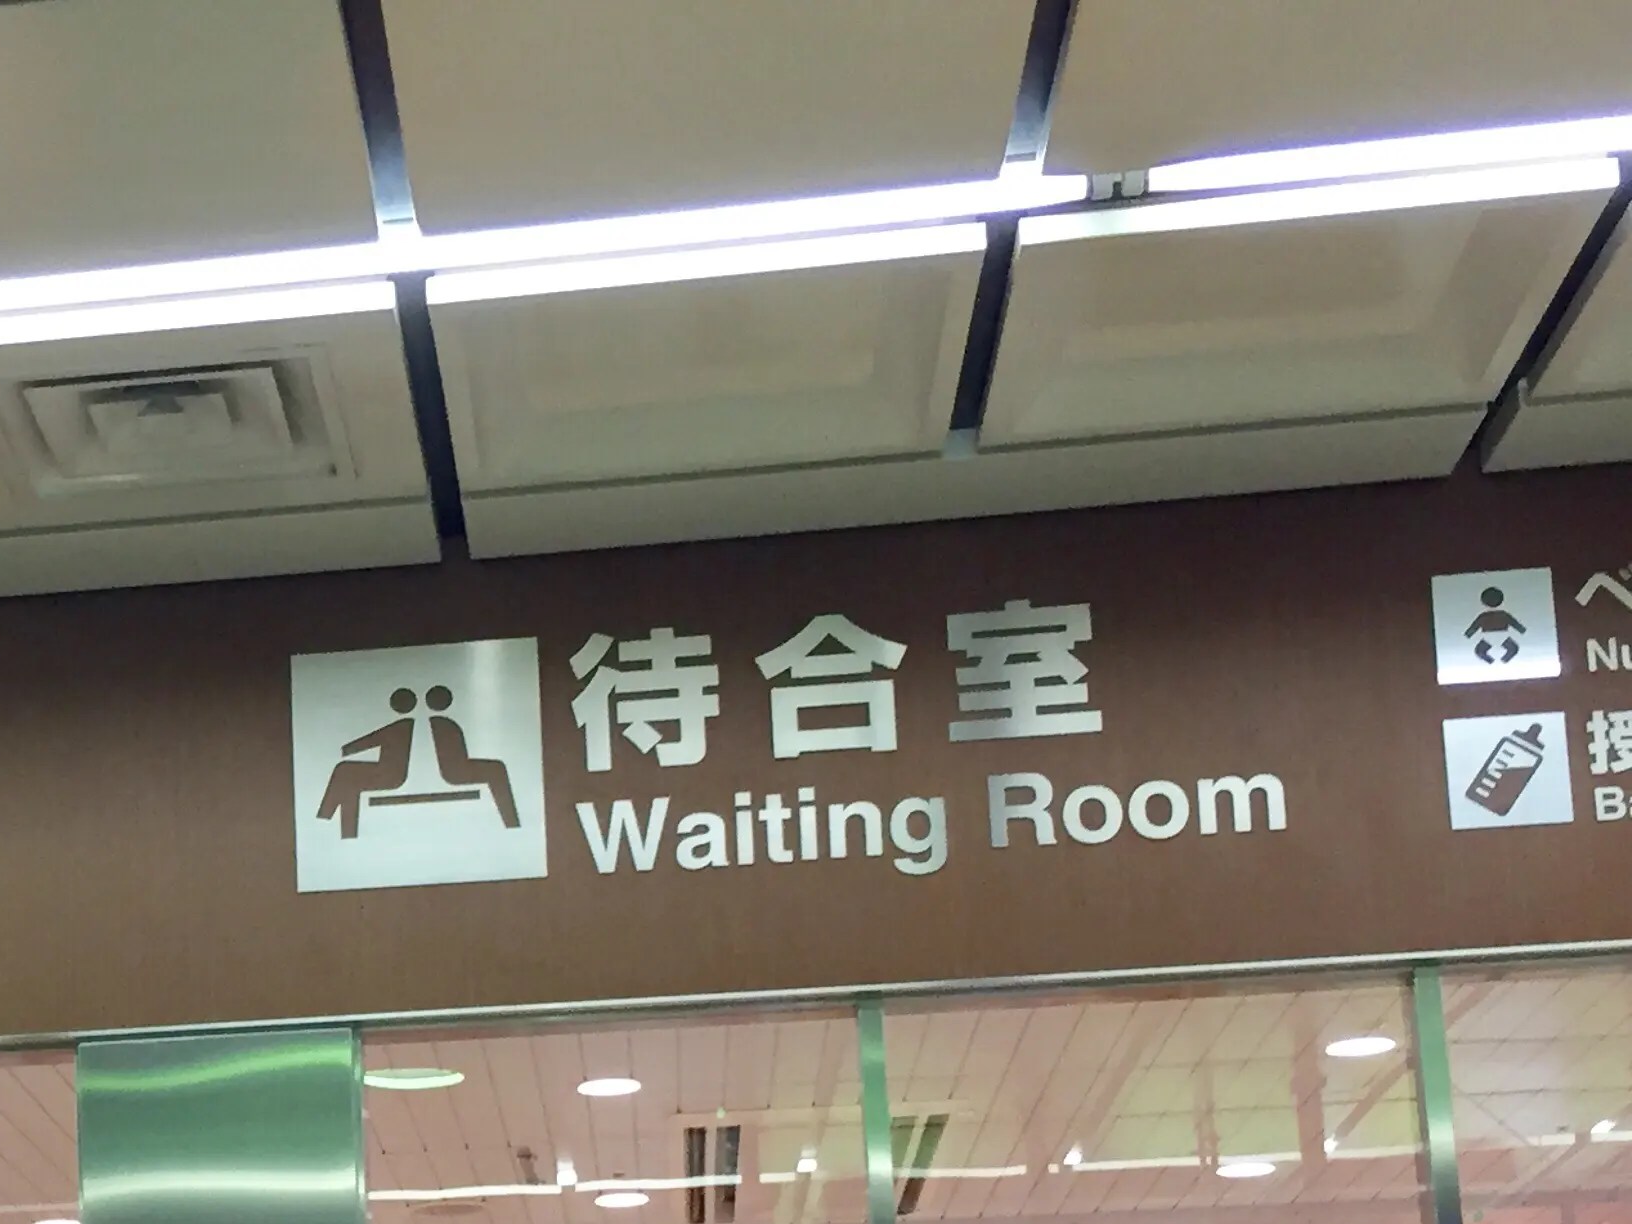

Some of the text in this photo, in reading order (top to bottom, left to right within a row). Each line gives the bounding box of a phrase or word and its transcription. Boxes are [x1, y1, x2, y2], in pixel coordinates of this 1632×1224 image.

[570, 600, 1103, 771] 待合室
[576, 772, 1287, 875] Waiting Room
